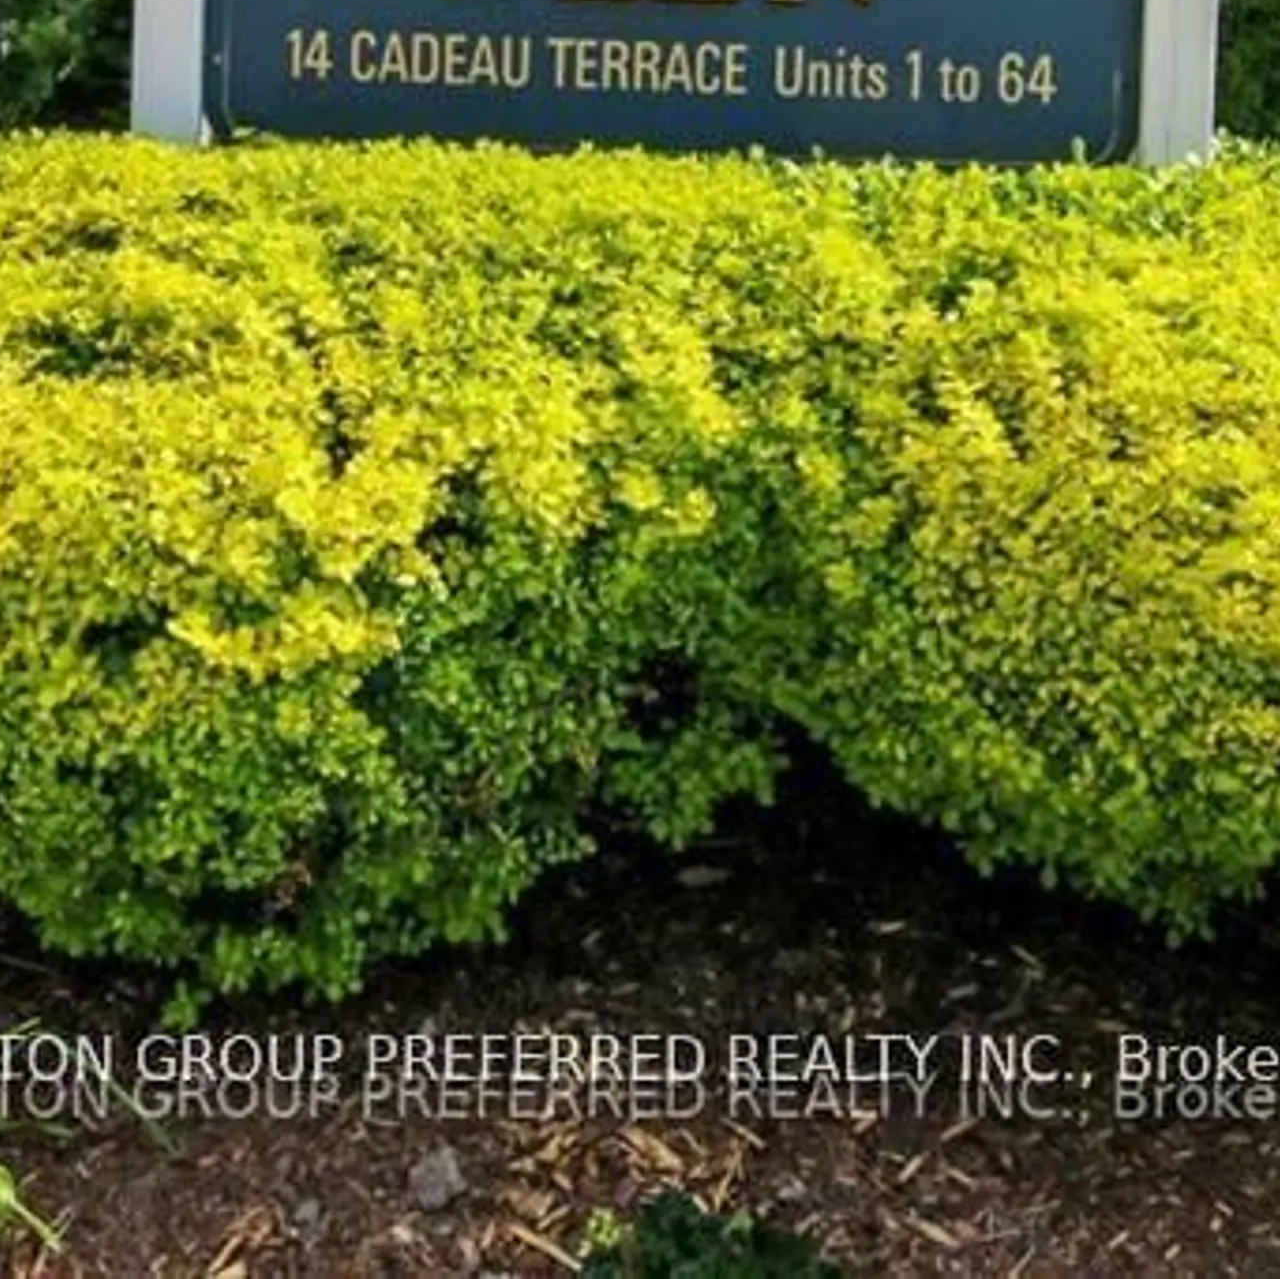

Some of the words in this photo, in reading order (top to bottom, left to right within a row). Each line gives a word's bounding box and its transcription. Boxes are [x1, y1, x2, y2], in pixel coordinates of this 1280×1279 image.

[286, 28, 334, 82] 14
[349, 29, 532, 88] CADEAU
[546, 36, 749, 96] TERRACE
[774, 44, 889, 100] Units
[904, 49, 923, 103] 1
[937, 57, 981, 104] to
[997, 51, 1059, 105] 64
